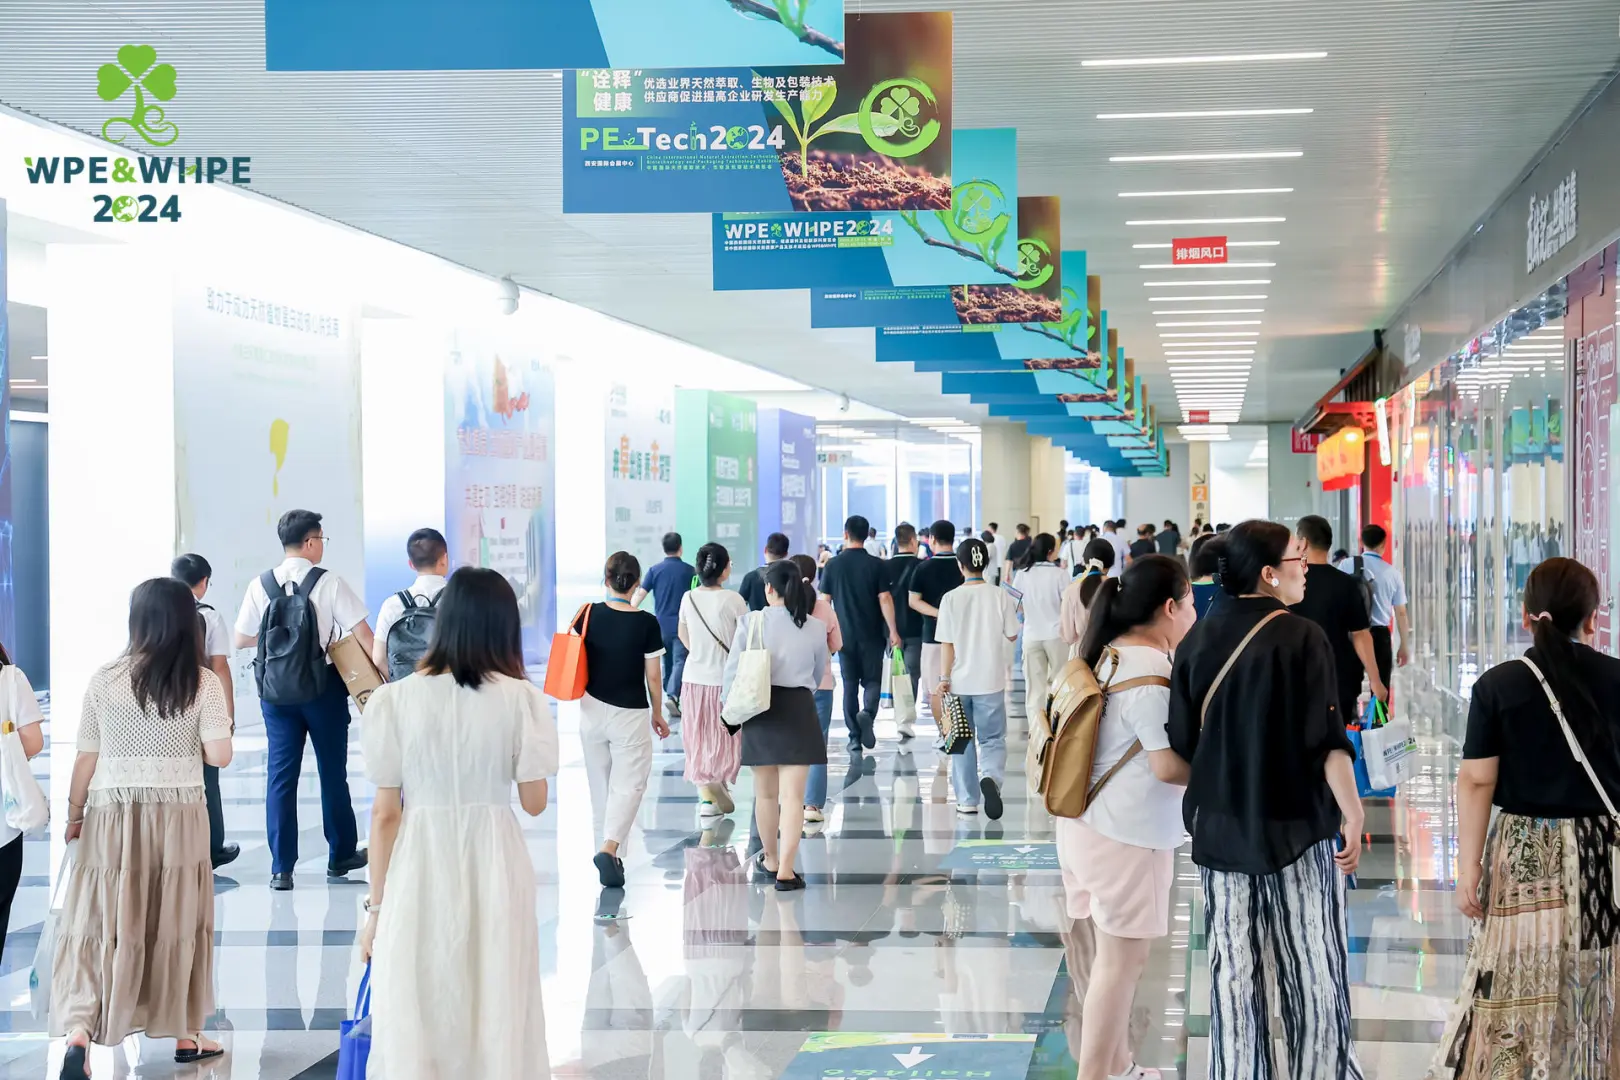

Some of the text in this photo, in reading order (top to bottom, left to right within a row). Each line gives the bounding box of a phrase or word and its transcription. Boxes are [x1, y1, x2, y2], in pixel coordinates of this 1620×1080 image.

[643, 76, 836, 89] 优选业界天然萃取、生物及包装技术
[592, 91, 633, 112] 健康
[643, 89, 823, 103] 供应商促进提高企业研发生产能力
[1176, 246, 1224, 260] 排烟风口
